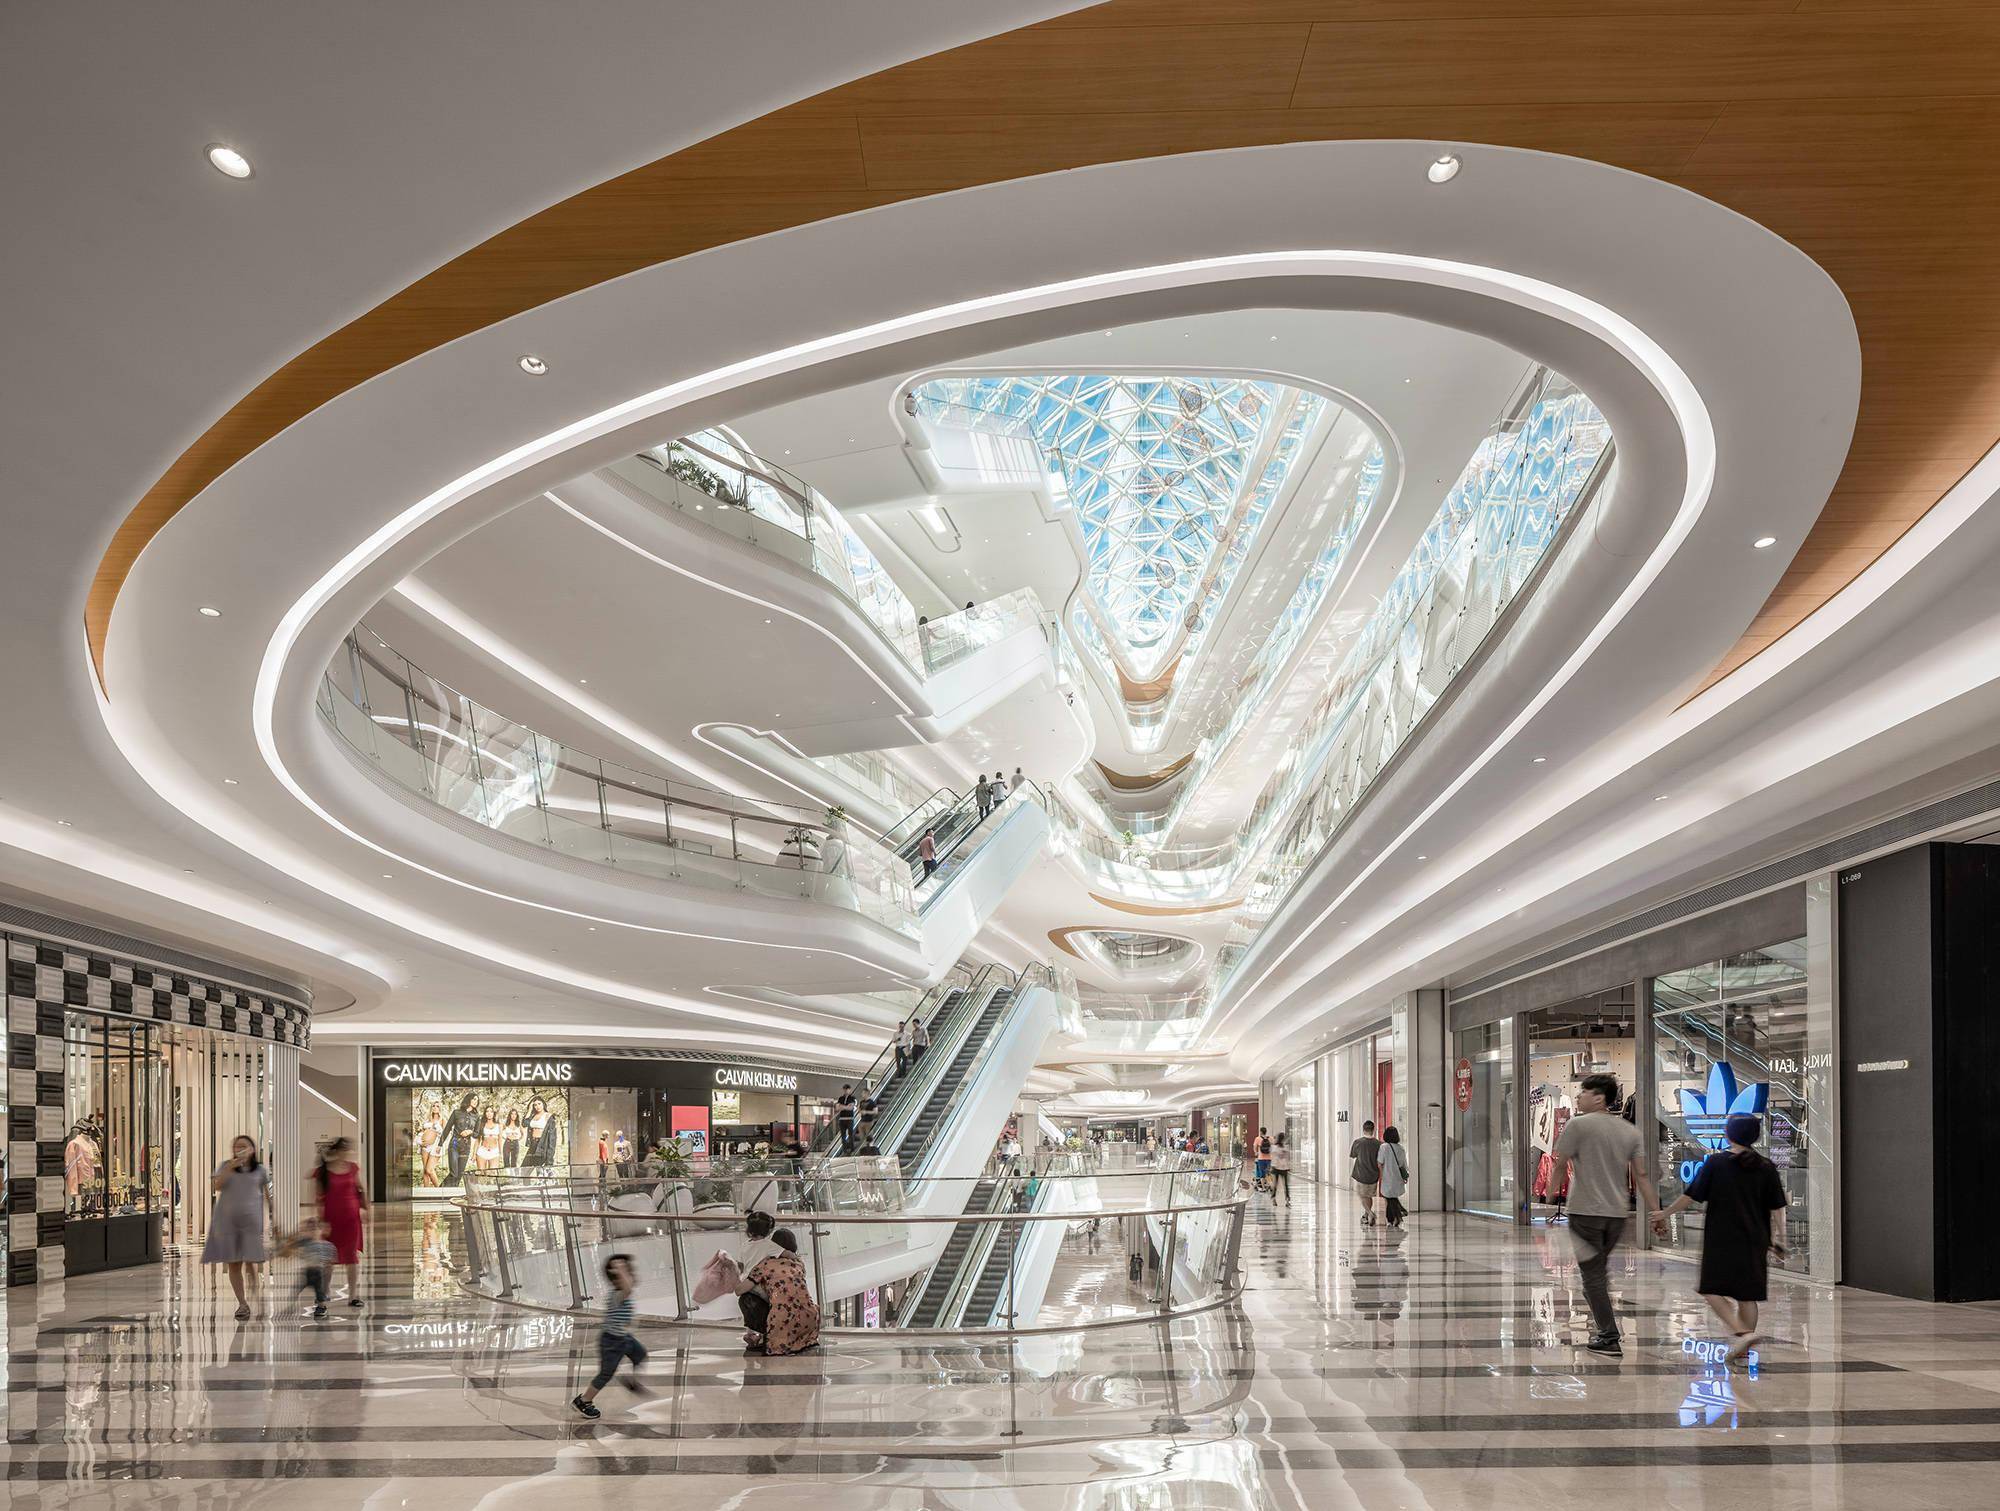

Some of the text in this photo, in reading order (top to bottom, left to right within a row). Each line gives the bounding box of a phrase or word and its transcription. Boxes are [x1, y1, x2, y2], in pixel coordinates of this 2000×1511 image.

[384, 1063, 572, 1082] CALVIN KLEIN JEANS
[715, 1068, 797, 1090] CALVIN KLEIN JEANS
